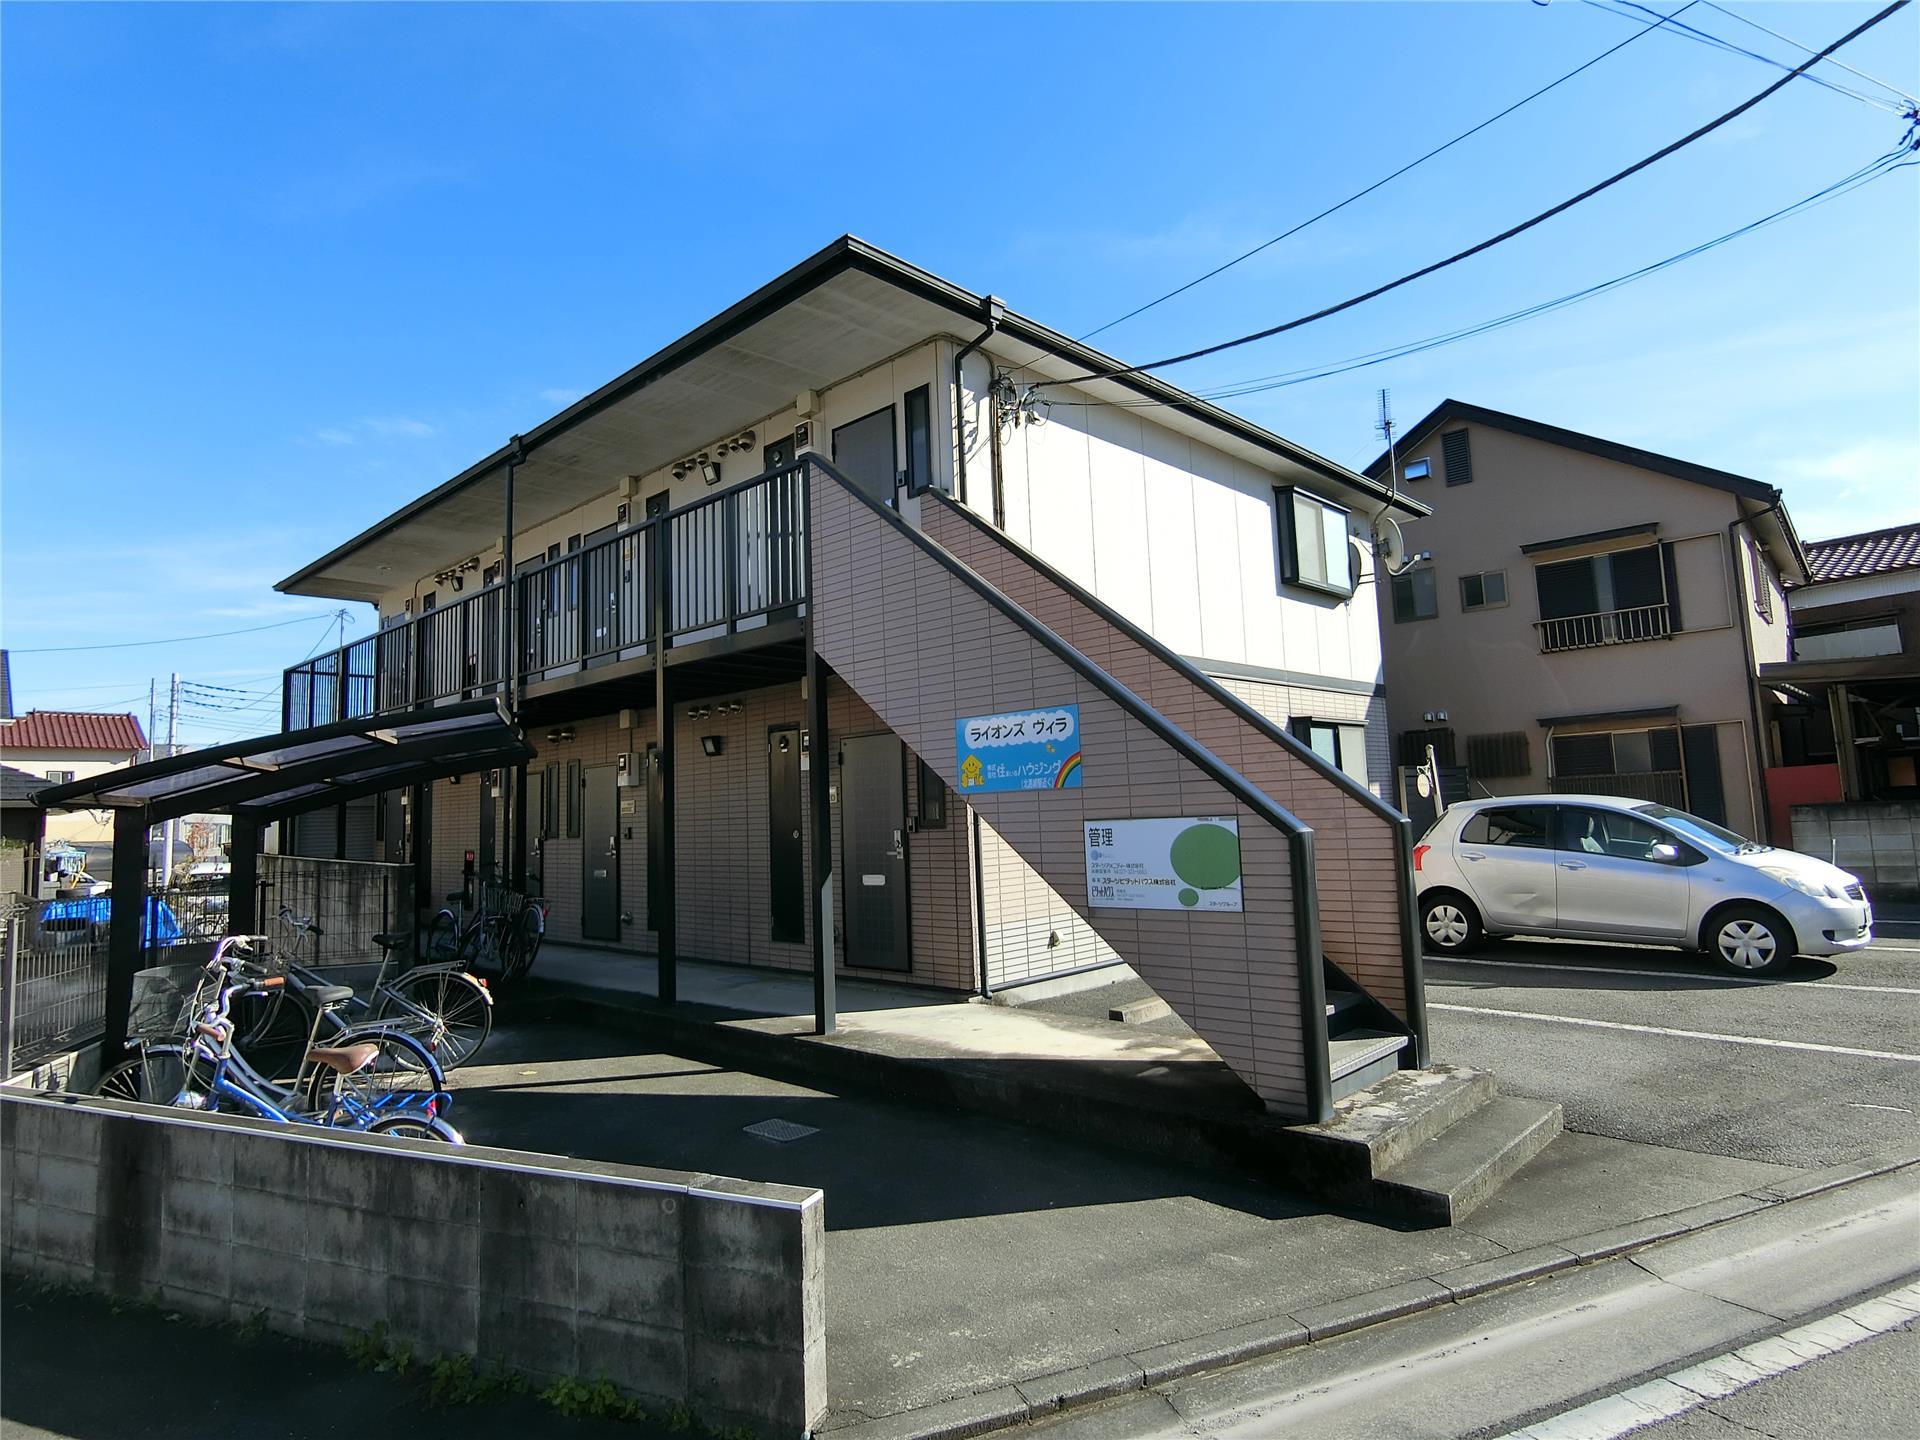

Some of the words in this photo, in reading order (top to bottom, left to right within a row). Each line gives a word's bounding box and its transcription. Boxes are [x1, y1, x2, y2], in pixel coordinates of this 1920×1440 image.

[971, 720, 1025, 742] ライオンズ
[1032, 717, 1068, 735] ヴィラ
[1088, 827, 1114, 848] 管理
